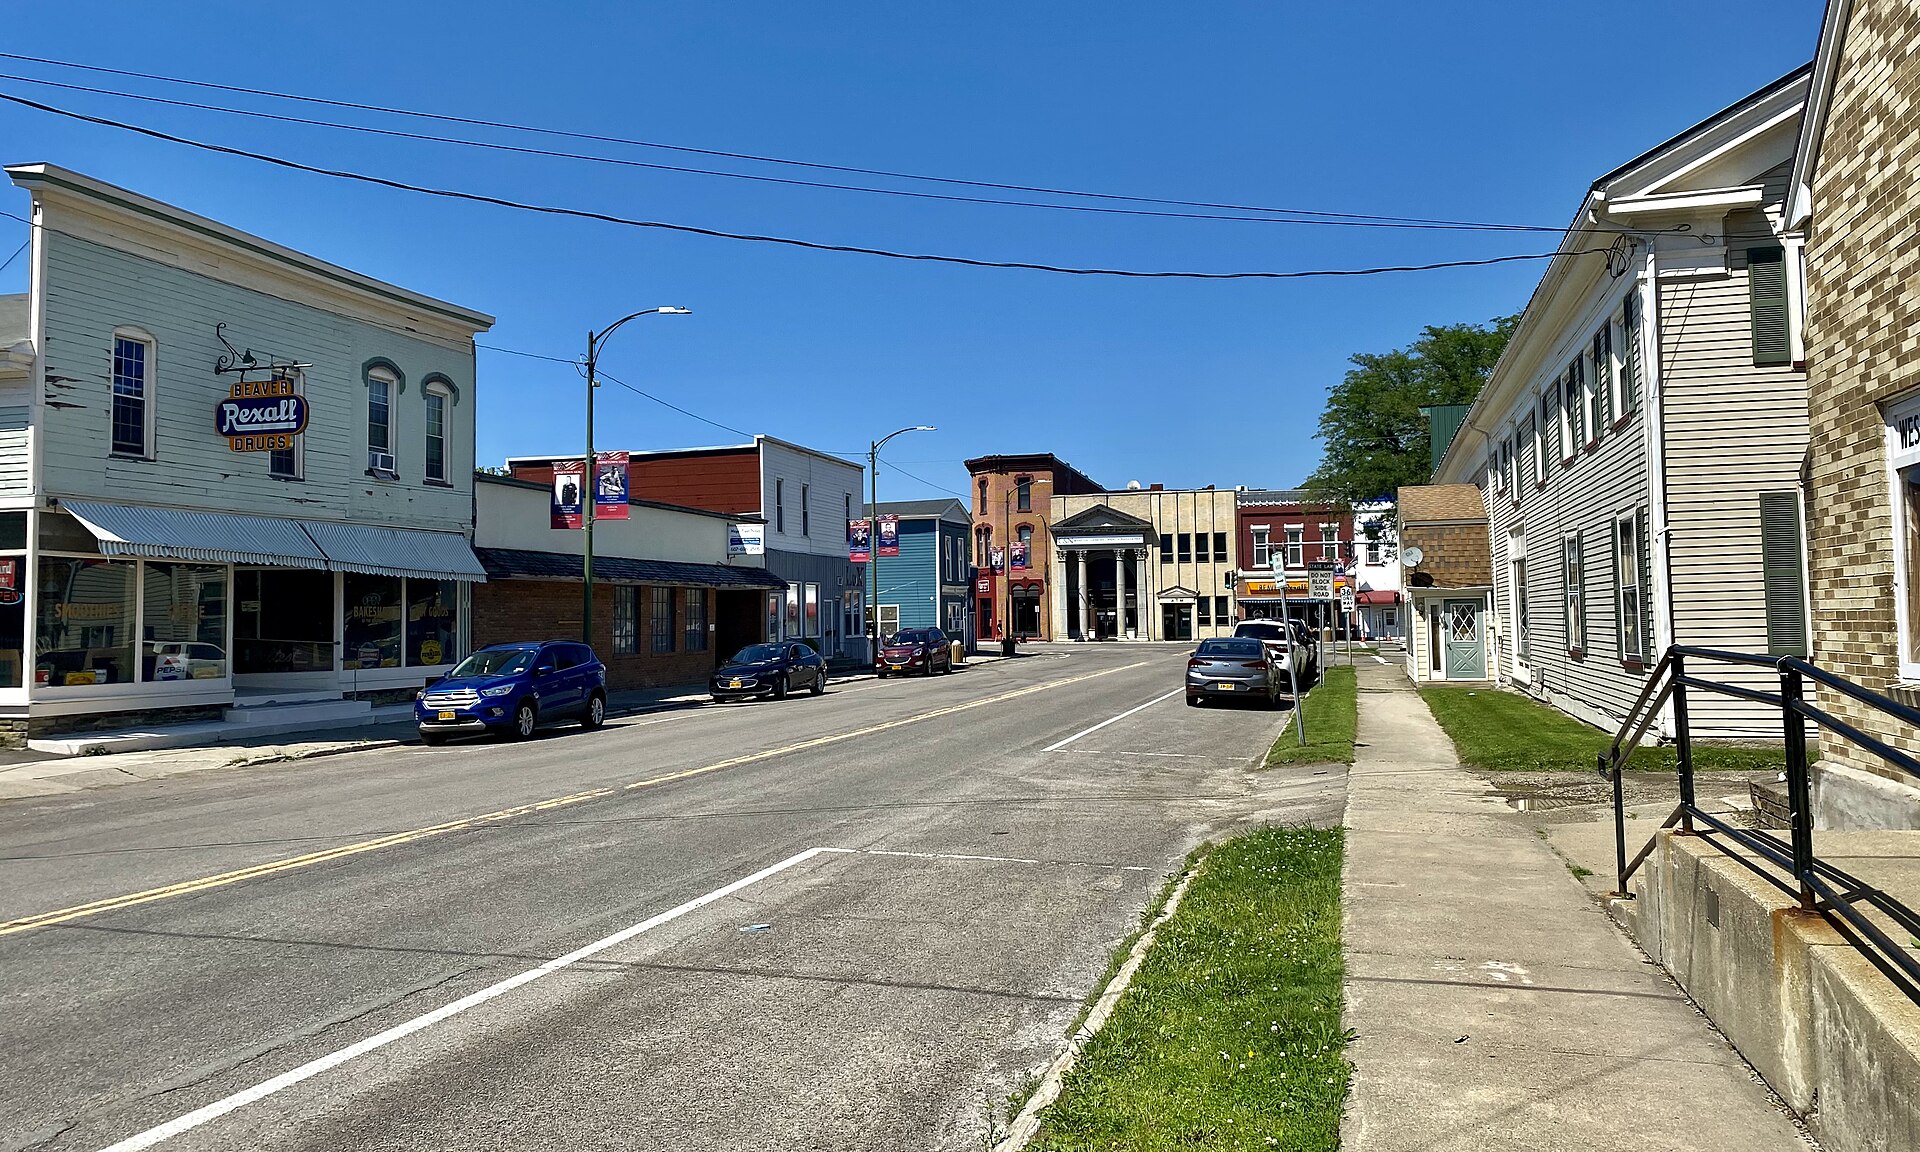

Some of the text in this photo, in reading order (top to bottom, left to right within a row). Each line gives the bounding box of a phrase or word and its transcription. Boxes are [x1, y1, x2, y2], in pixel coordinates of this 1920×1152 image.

[233, 381, 289, 397] BEAVER
[222, 398, 297, 433] Rexall
[1899, 412, 1920, 450] WES
[234, 435, 287, 451] DRUGS
[1341, 588, 1351, 596] 36
[156, 666, 185, 674] PEPSI
